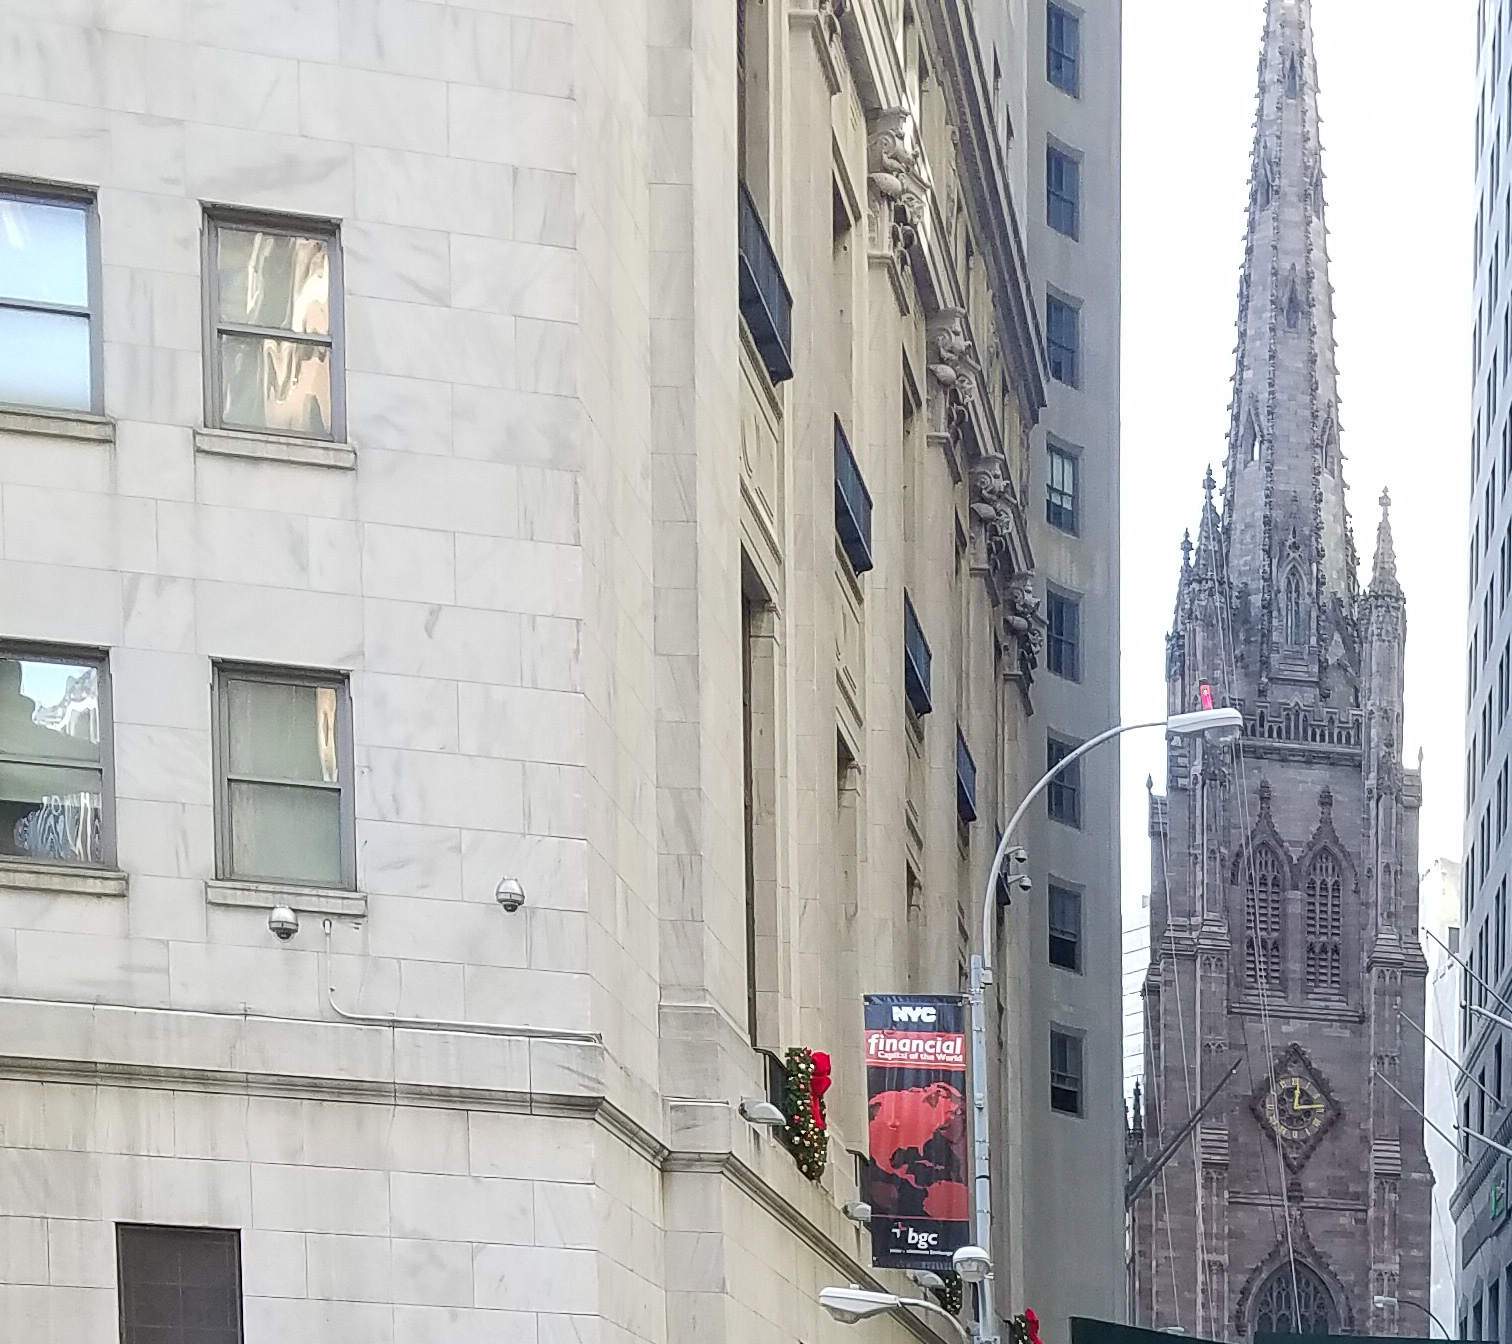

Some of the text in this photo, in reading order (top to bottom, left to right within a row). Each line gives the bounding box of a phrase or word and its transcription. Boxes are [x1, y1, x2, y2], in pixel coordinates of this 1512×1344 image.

[891, 1006, 937, 1023] NYC
[867, 1034, 963, 1055] financial
[907, 1227, 939, 1250] bgc
